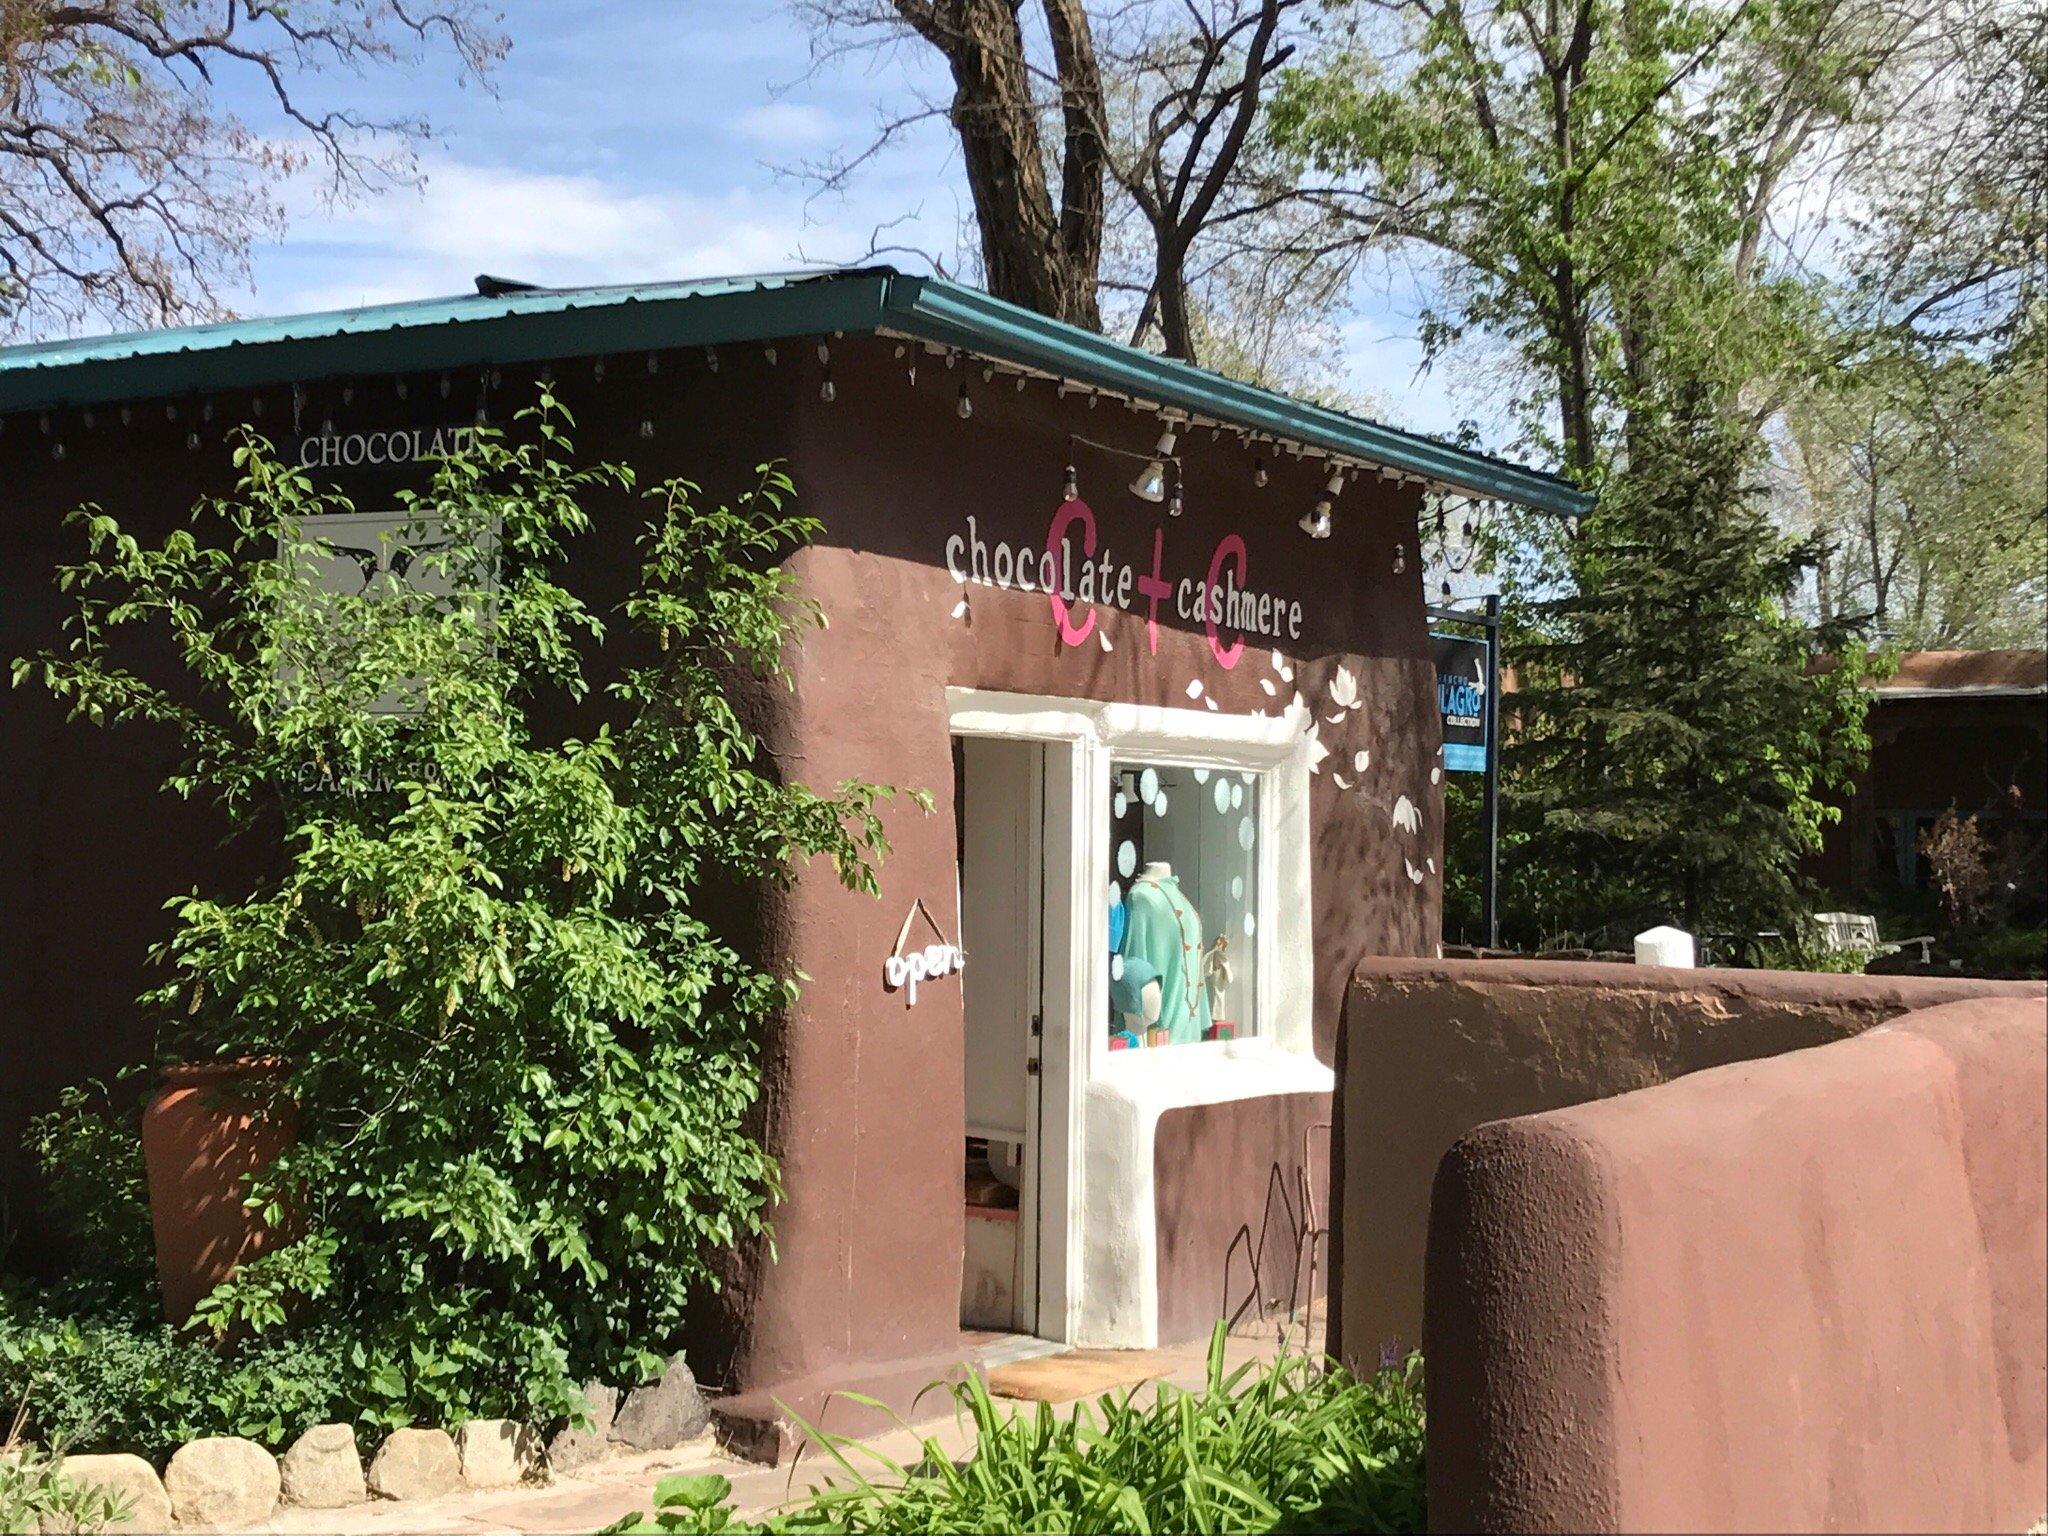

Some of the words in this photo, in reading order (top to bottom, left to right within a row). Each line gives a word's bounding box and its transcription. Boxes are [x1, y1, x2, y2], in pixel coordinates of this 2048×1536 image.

[946, 516, 1132, 609] chocolate
[1177, 570, 1302, 640] cashmere
[885, 945, 965, 1006] open
